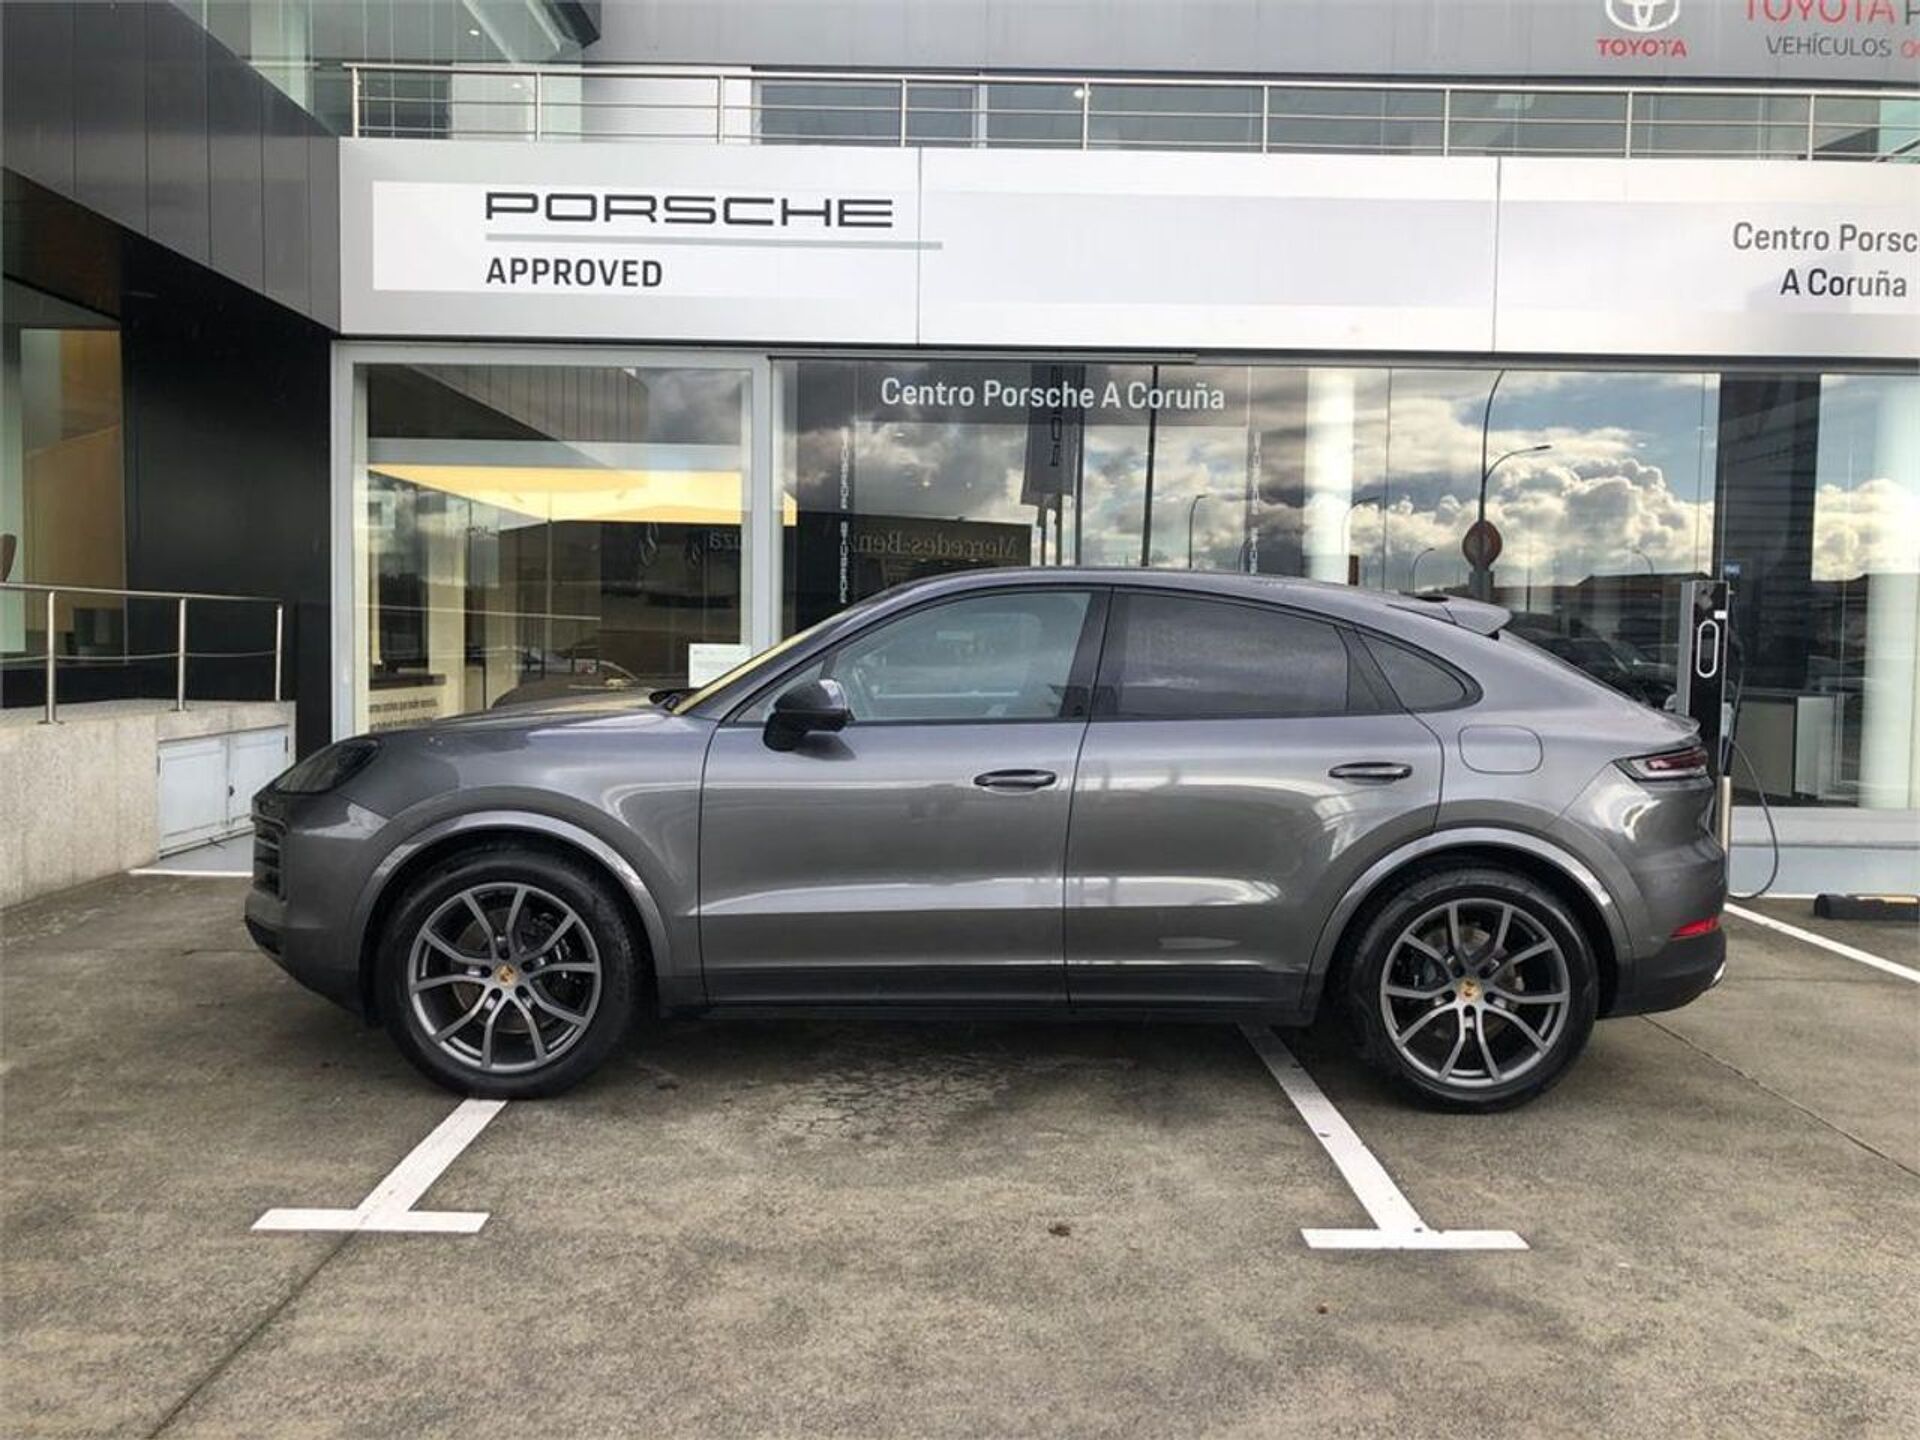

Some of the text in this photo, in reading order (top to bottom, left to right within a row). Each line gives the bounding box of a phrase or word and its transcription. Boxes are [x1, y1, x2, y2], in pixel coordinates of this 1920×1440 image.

[1745, 0, 1895, 24] TOYOTA
[1597, 38, 1688, 58] TOYOTA
[1766, 32, 1892, 58] VEHÍCULOS
[485, 192, 893, 228] PORSCHE
[1733, 222, 1830, 251] Centro
[486, 257, 663, 288] APPROVED
[1779, 267, 1907, 298] A Coruña
[881, 377, 1225, 410] Centro Porsche A Coruña
